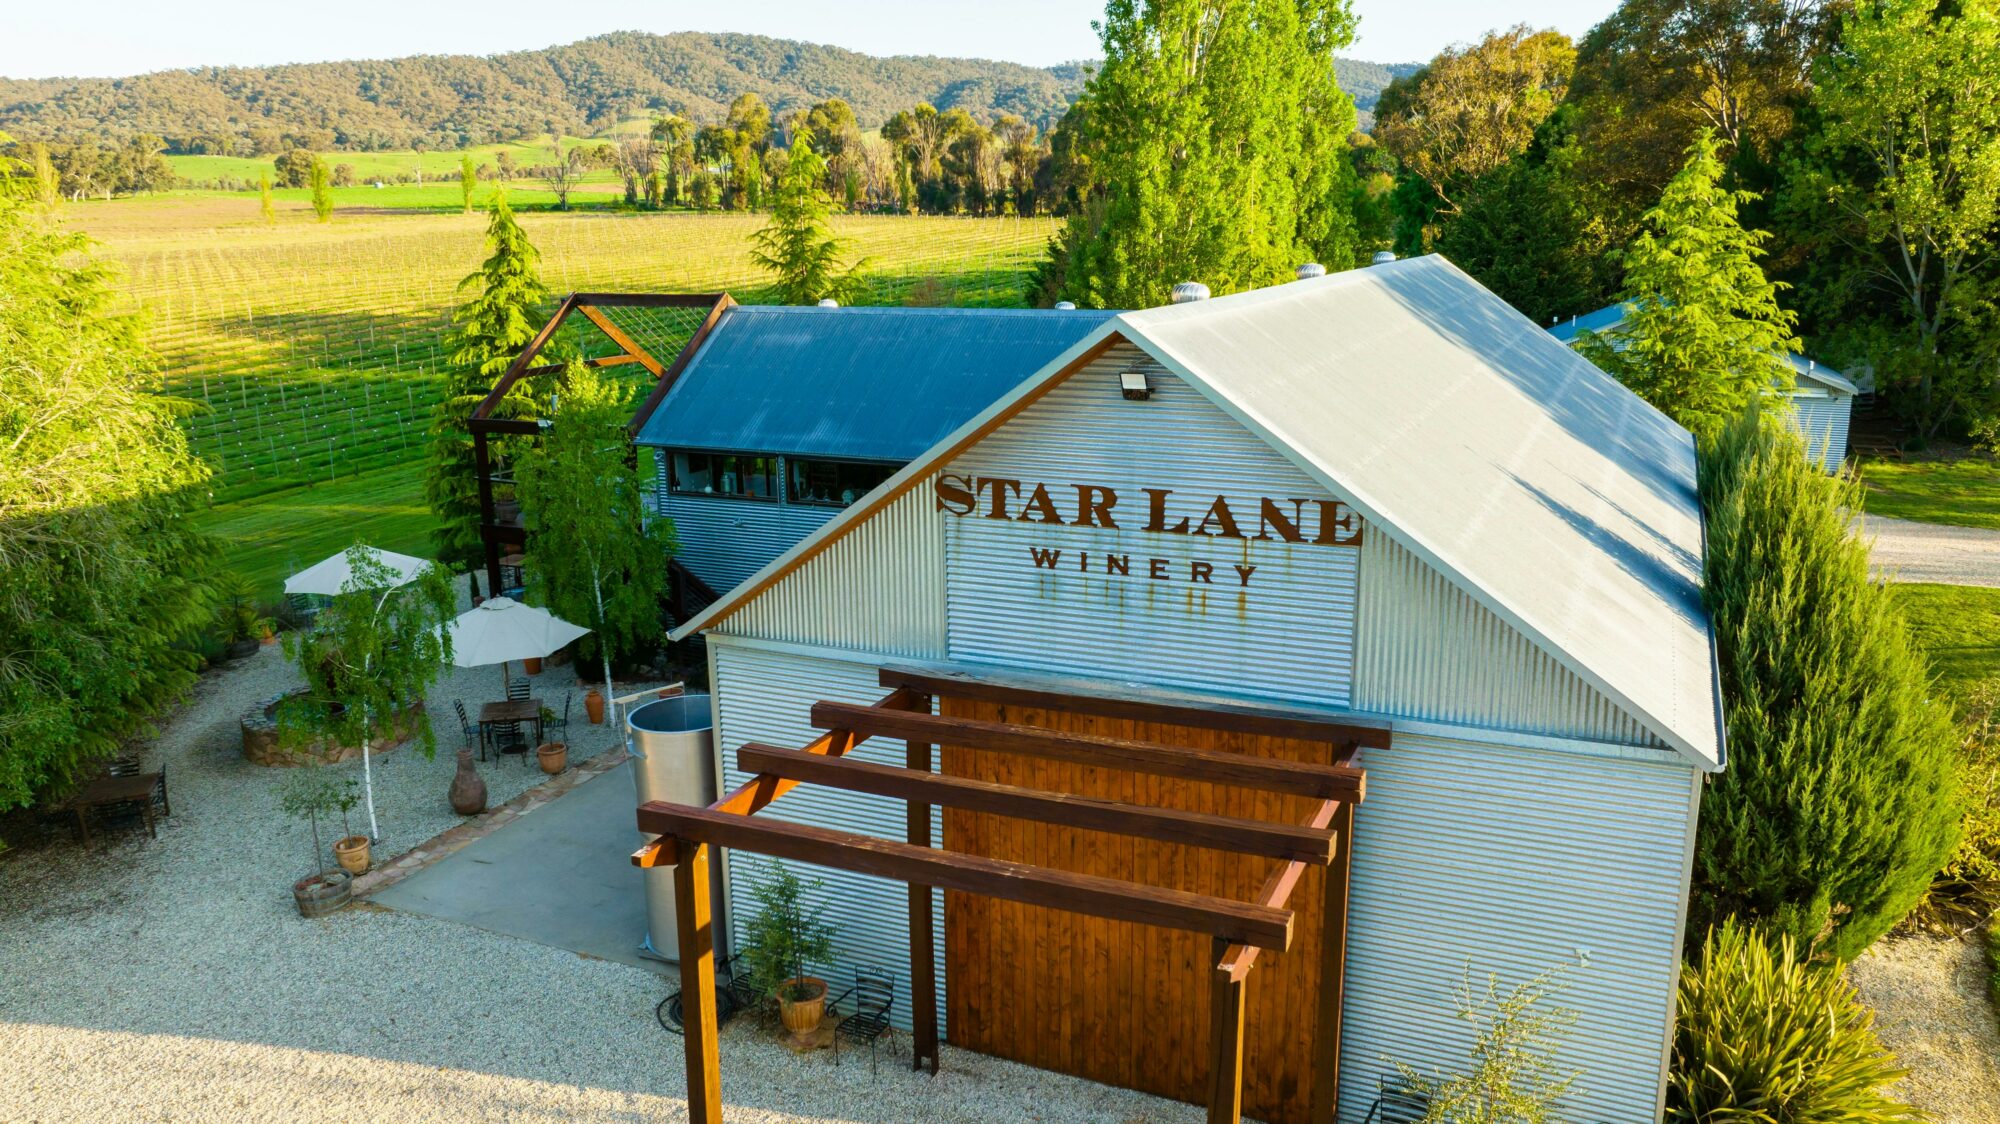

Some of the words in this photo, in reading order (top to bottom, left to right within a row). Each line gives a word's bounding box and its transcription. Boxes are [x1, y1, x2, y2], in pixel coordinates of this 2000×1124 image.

[935, 474, 1119, 528] STAR
[1141, 488, 1363, 546] LANE
[1030, 547, 1257, 587] WINERY
